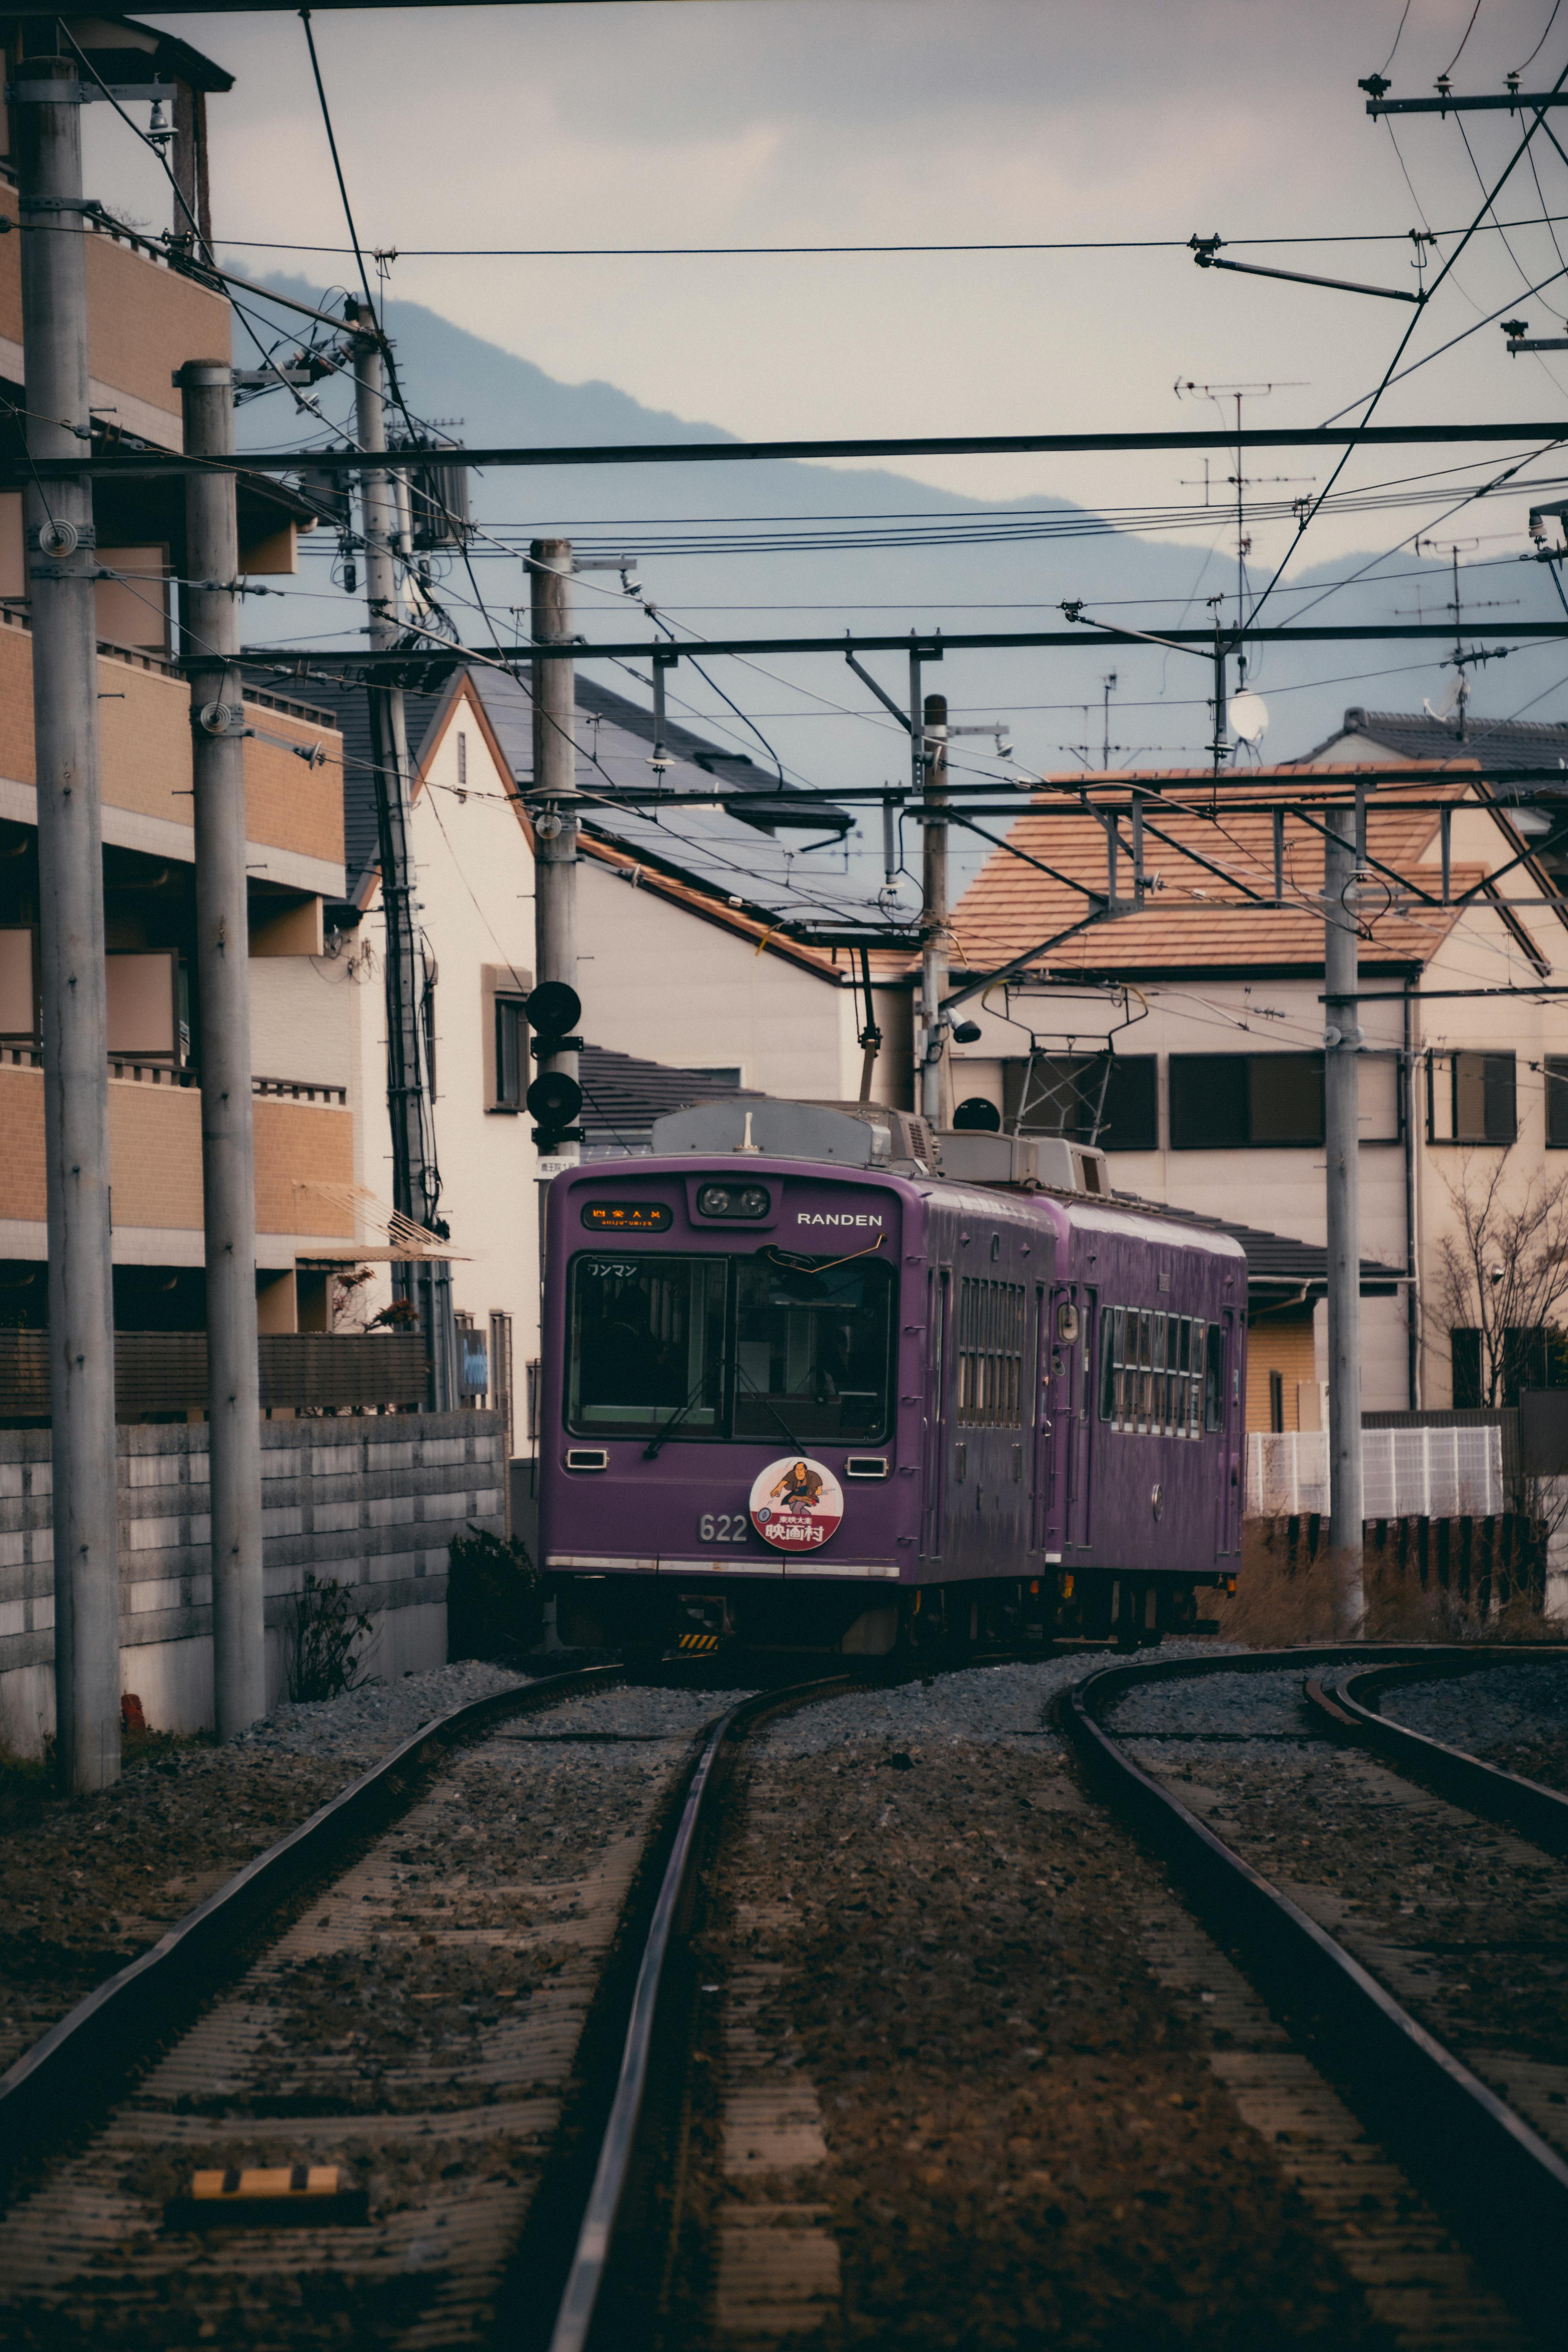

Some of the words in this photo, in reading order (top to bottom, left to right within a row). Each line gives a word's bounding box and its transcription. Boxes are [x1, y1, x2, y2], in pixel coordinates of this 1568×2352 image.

[797, 1213, 882, 1226] RANDEN
[588, 1263, 637, 1277] ワンマン
[779, 1516, 813, 1524] 東映太秦
[700, 1514, 747, 1541] 622
[766, 1523, 824, 1542] 映画村
